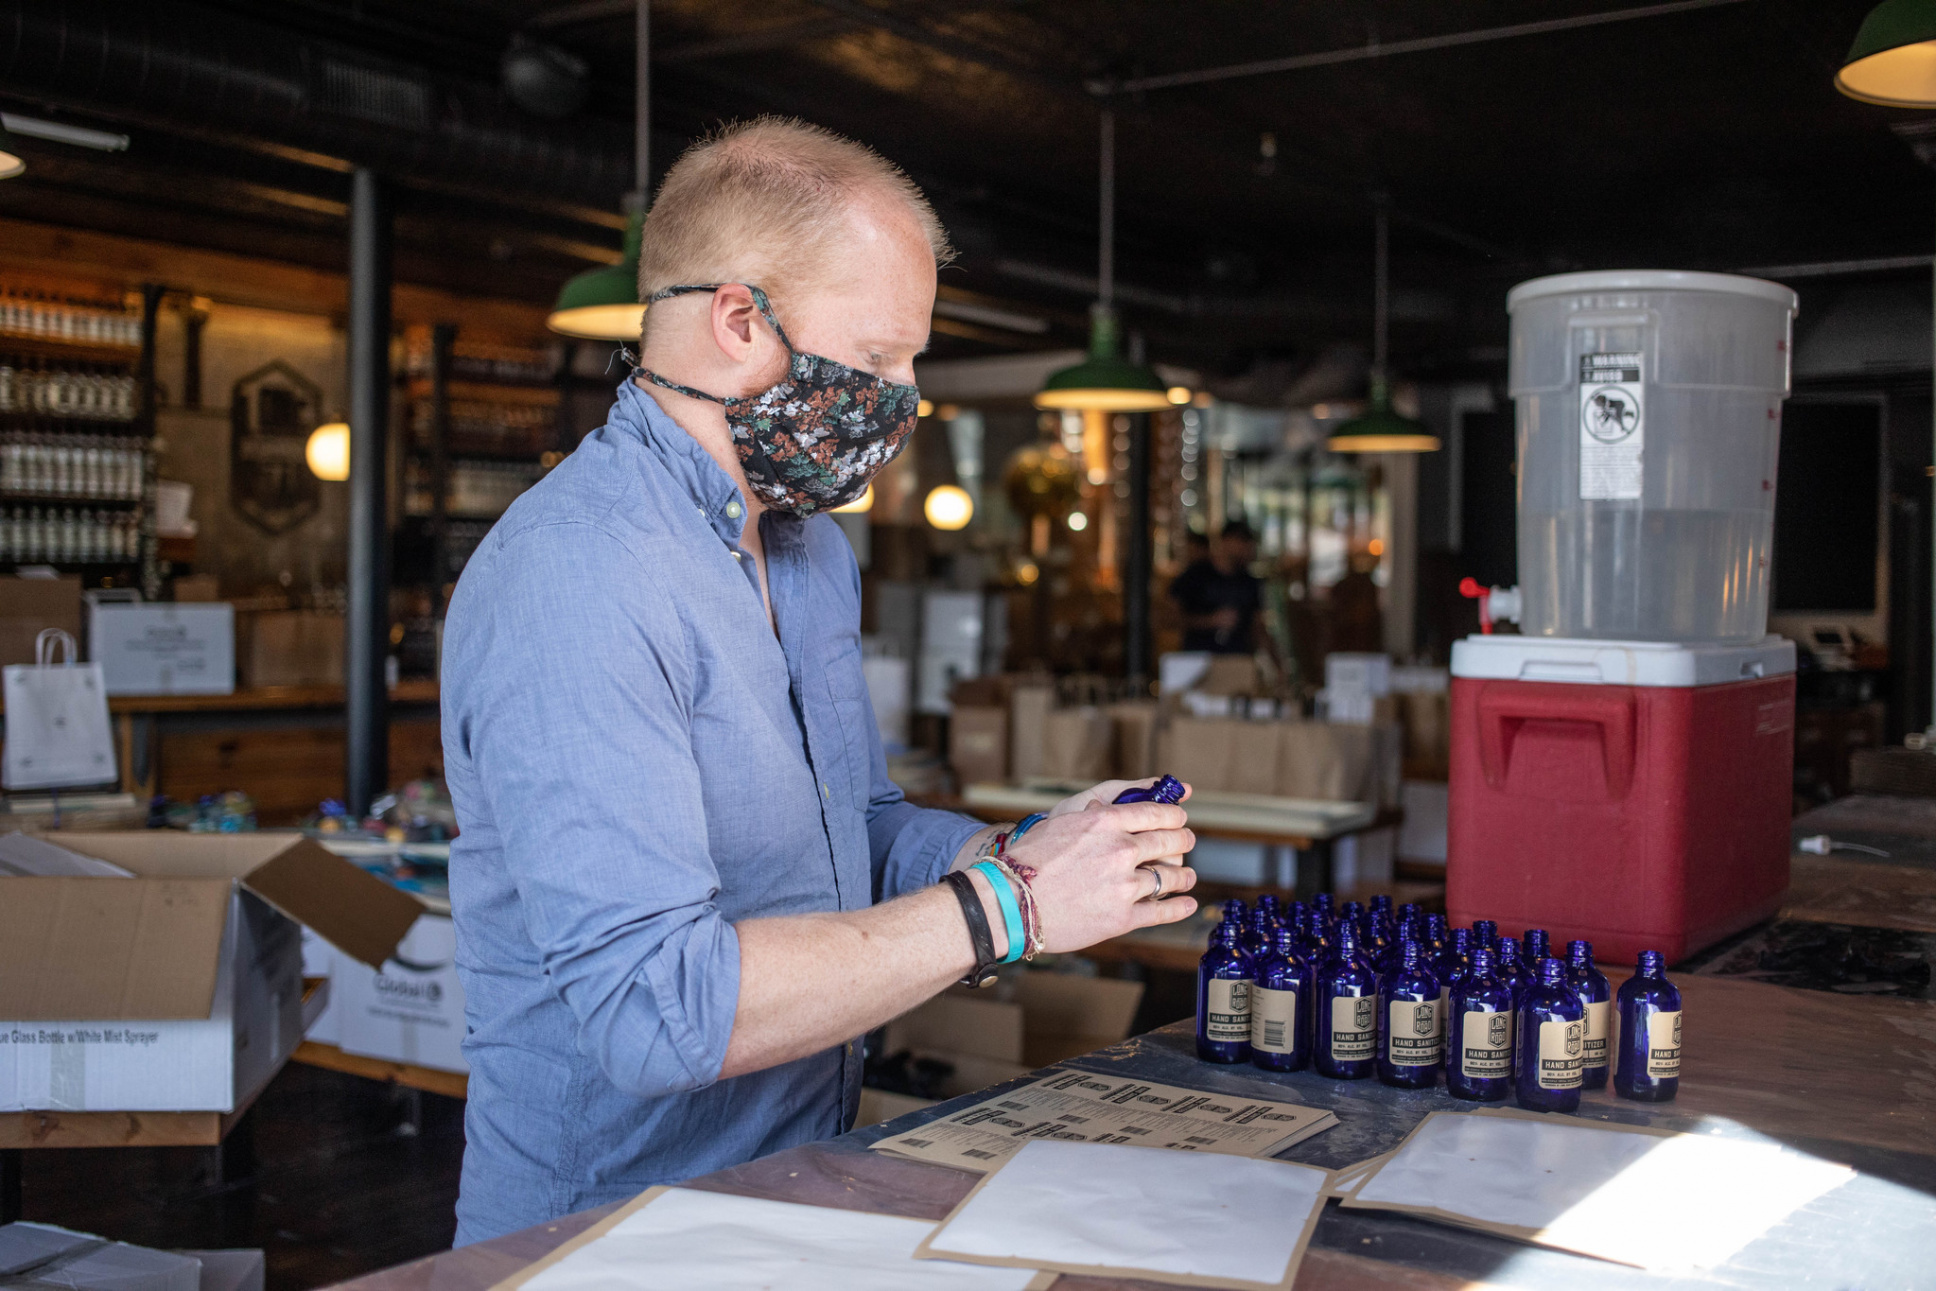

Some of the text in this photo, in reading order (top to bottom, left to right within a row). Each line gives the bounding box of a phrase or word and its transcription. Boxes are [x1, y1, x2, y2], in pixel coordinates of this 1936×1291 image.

[1416, 1006, 1432, 1019] LONG
[1211, 1015, 1230, 1023] HAND
[1416, 1020, 1432, 1032] ROAD
[1491, 1018, 1506, 1030] LONG
[11, 1029, 36, 1044] Glass
[38, 1029, 65, 1044] Bottle
[104, 1029, 122, 1044] Mist
[124, 1029, 159, 1048] Sprayer
[1336, 1033, 1355, 1041] HAND
[1395, 1039, 1414, 1047] HAND
[1584, 1040, 1605, 1049] ITIZER
[1468, 1050, 1488, 1059] HAND
[1654, 1050, 1671, 1058] HAND
[1545, 1061, 1565, 1069] HAND
